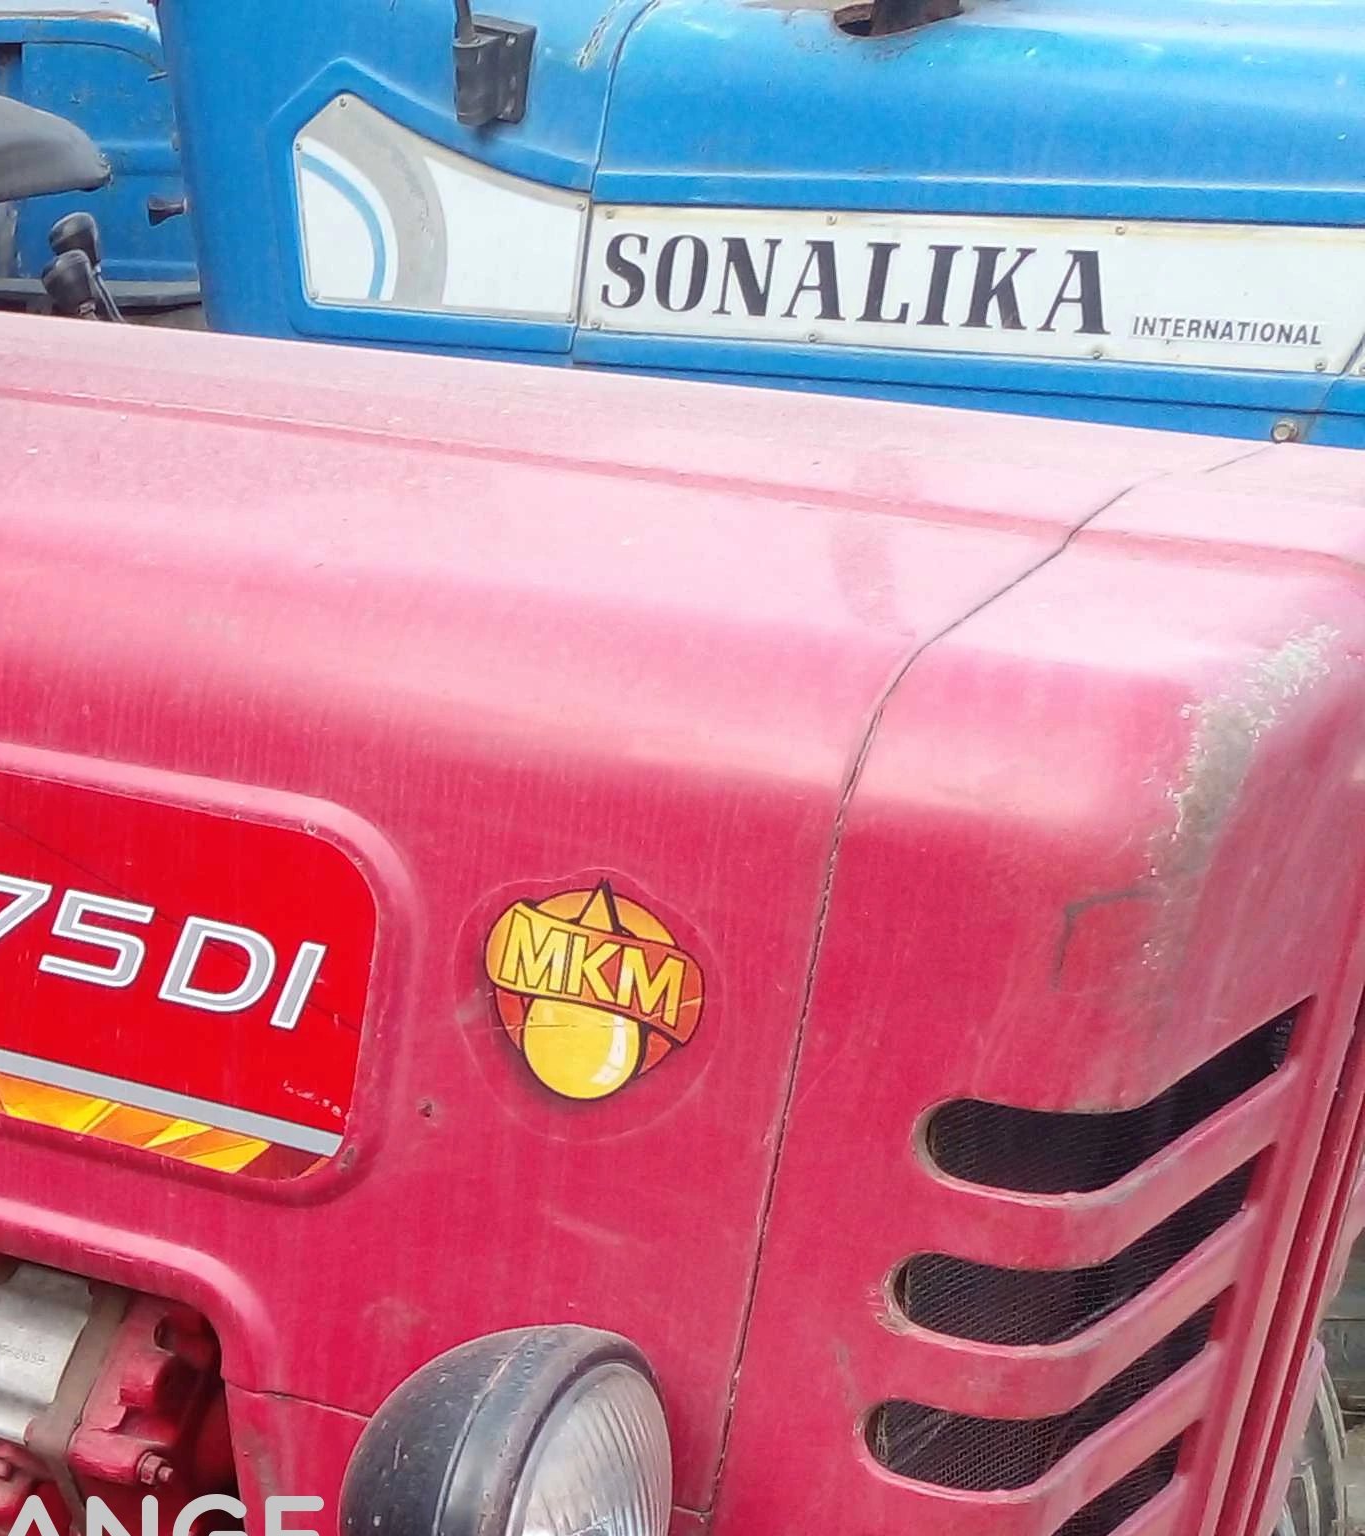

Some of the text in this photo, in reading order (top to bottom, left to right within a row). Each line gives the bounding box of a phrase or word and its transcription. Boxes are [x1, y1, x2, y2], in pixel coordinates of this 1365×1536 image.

[601, 233, 1111, 335] SONALIKA
[1132, 315, 1322, 345] INTERNATIONAL
[496, 907, 689, 1031] MKM
